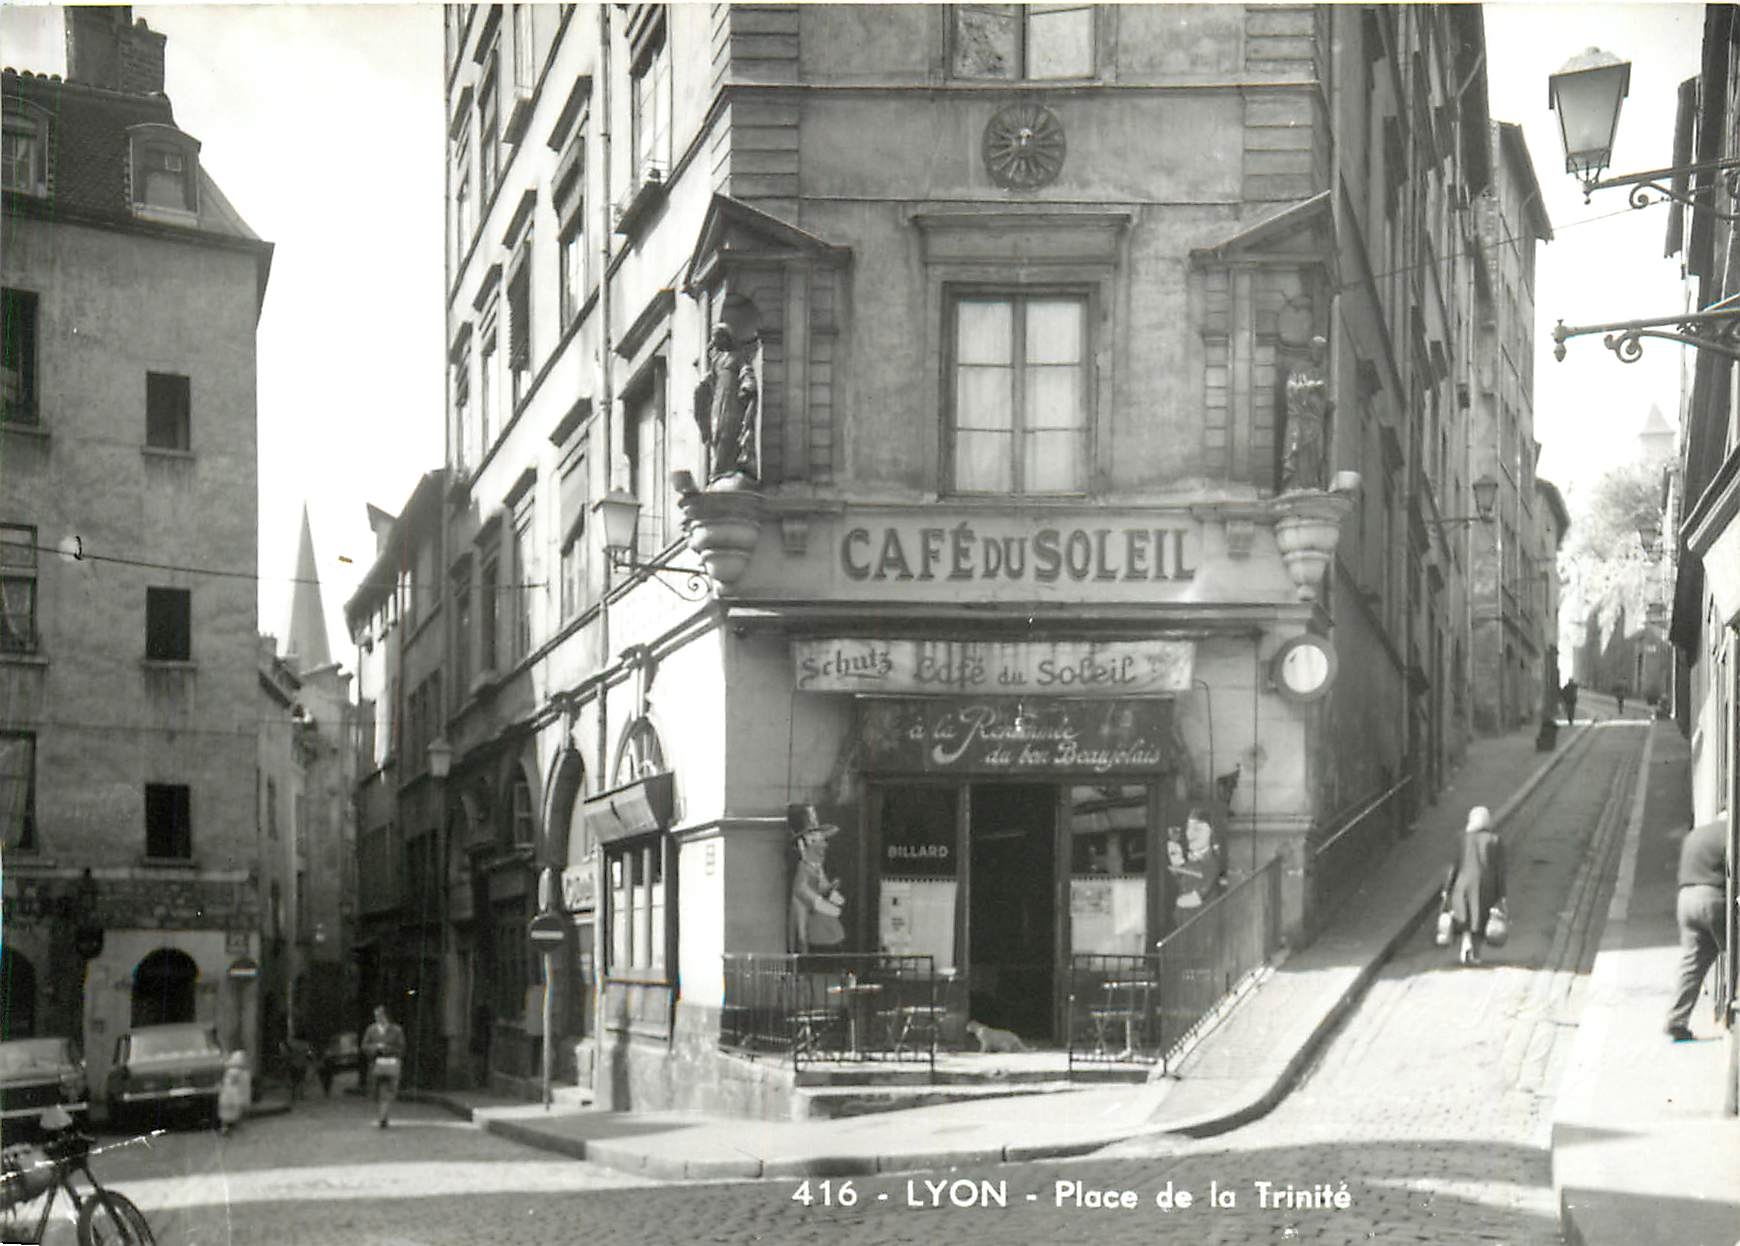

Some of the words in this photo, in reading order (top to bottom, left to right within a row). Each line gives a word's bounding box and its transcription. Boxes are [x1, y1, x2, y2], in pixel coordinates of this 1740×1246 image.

[840, 520, 977, 582] CAFÉ
[981, 536, 1028, 581] DU
[1032, 528, 1196, 583] SOLEIL
[997, 666, 1027, 685] du
[1037, 656, 1136, 686] Soleil
[985, 743, 1012, 765] du
[1053, 737, 1161, 773] Beaujolais
[887, 845, 949, 858] BILLARD
